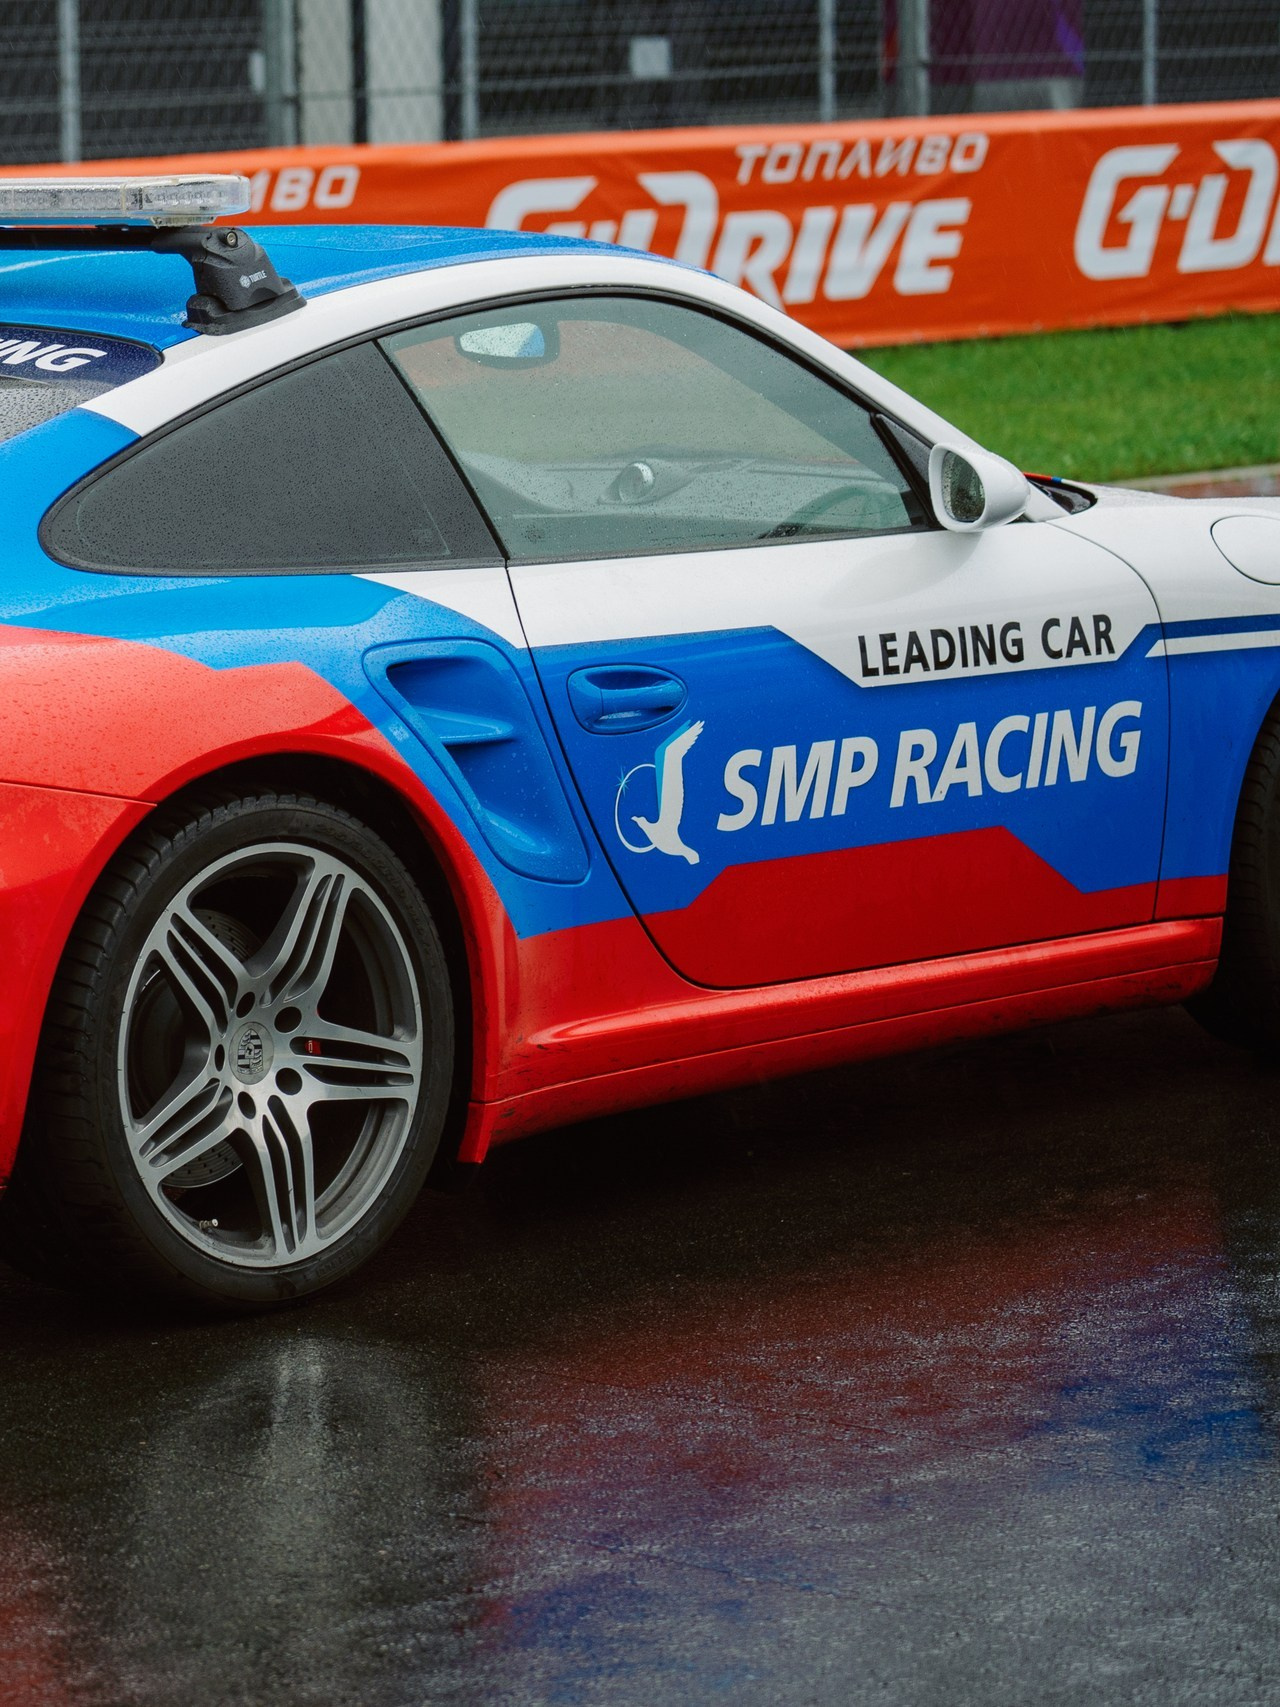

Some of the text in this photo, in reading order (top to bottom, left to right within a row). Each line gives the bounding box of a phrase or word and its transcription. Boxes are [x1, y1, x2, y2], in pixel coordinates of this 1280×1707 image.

[735, 131, 989, 186] ТОПЛИВО
[857, 614, 1117, 679] LEADING CAR
[716, 699, 1143, 832] SMP RACING
